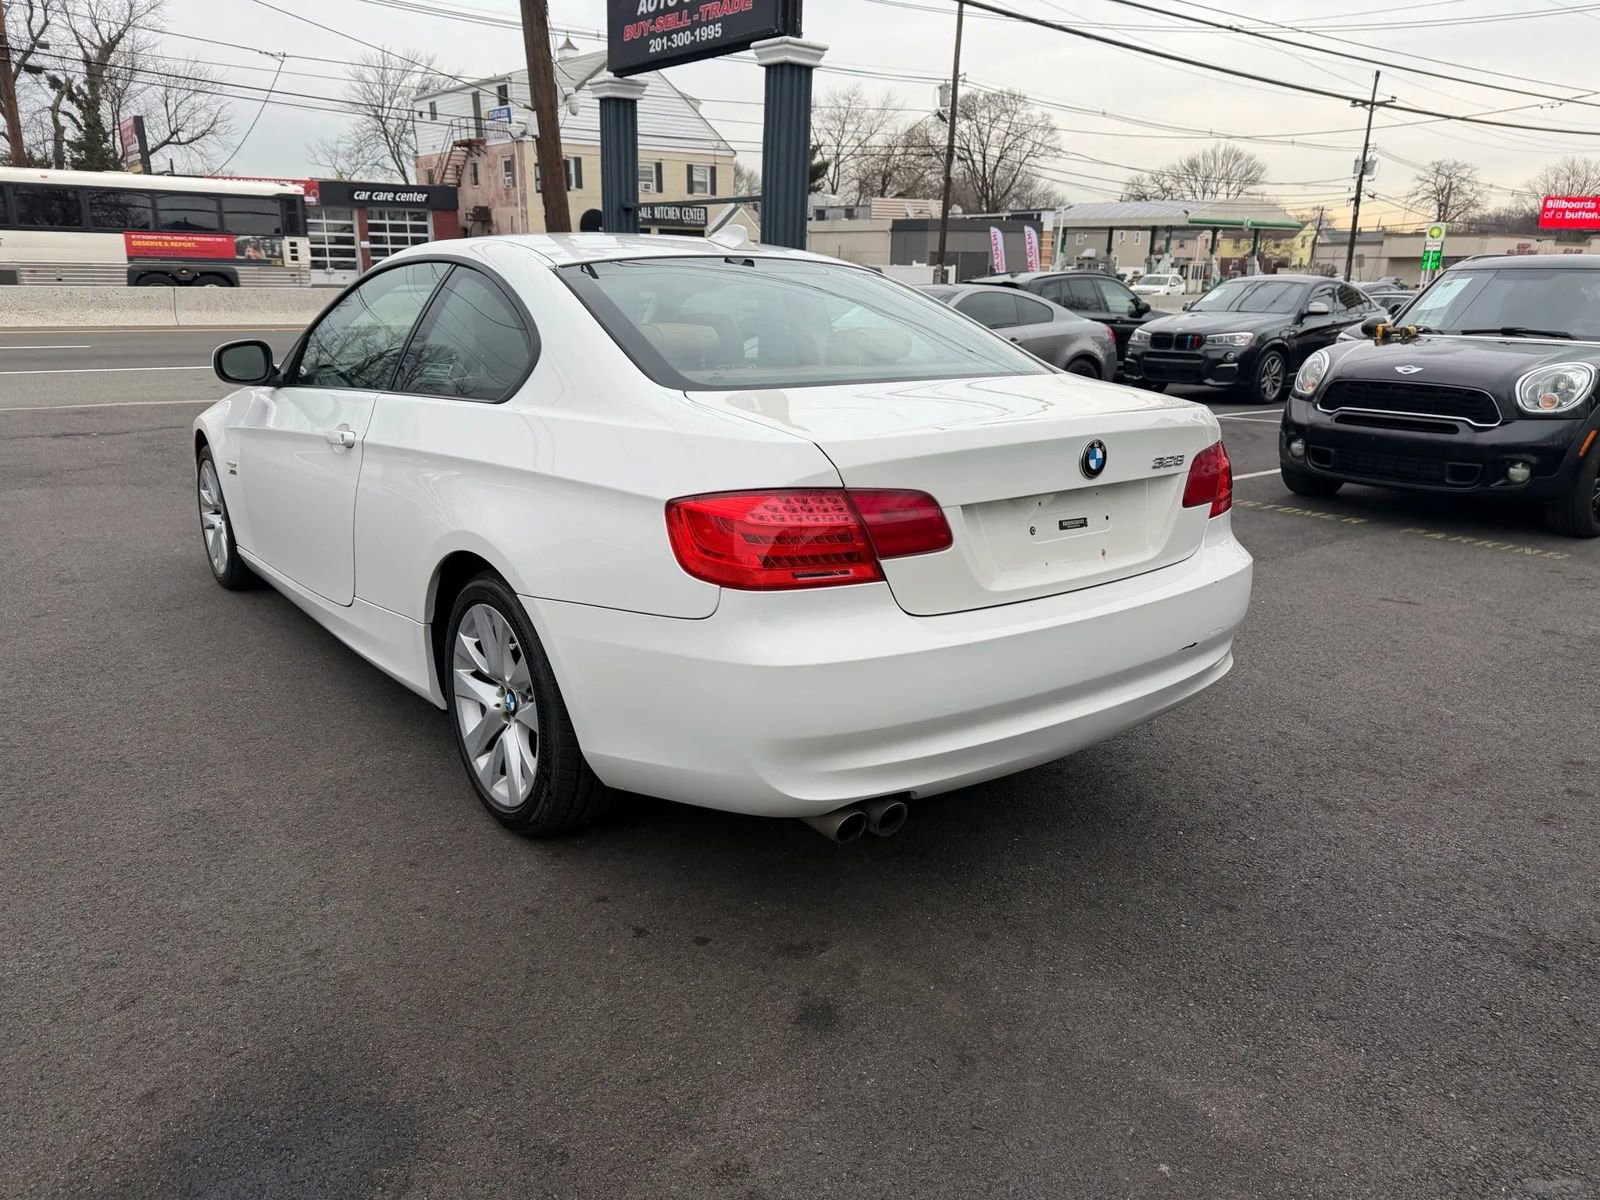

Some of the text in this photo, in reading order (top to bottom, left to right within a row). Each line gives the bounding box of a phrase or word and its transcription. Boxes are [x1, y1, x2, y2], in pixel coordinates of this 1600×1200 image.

[649, 23, 722, 52] 201-300-1995
[354, 190, 428, 202] car care center
[1546, 199, 1596, 209] Billboards
[654, 206, 680, 220] KITCHEN
[682, 207, 705, 221] CENTER
[1544, 210, 1554, 218] of
[1565, 211, 1600, 219] button.
[1152, 454, 1184, 469] 328
